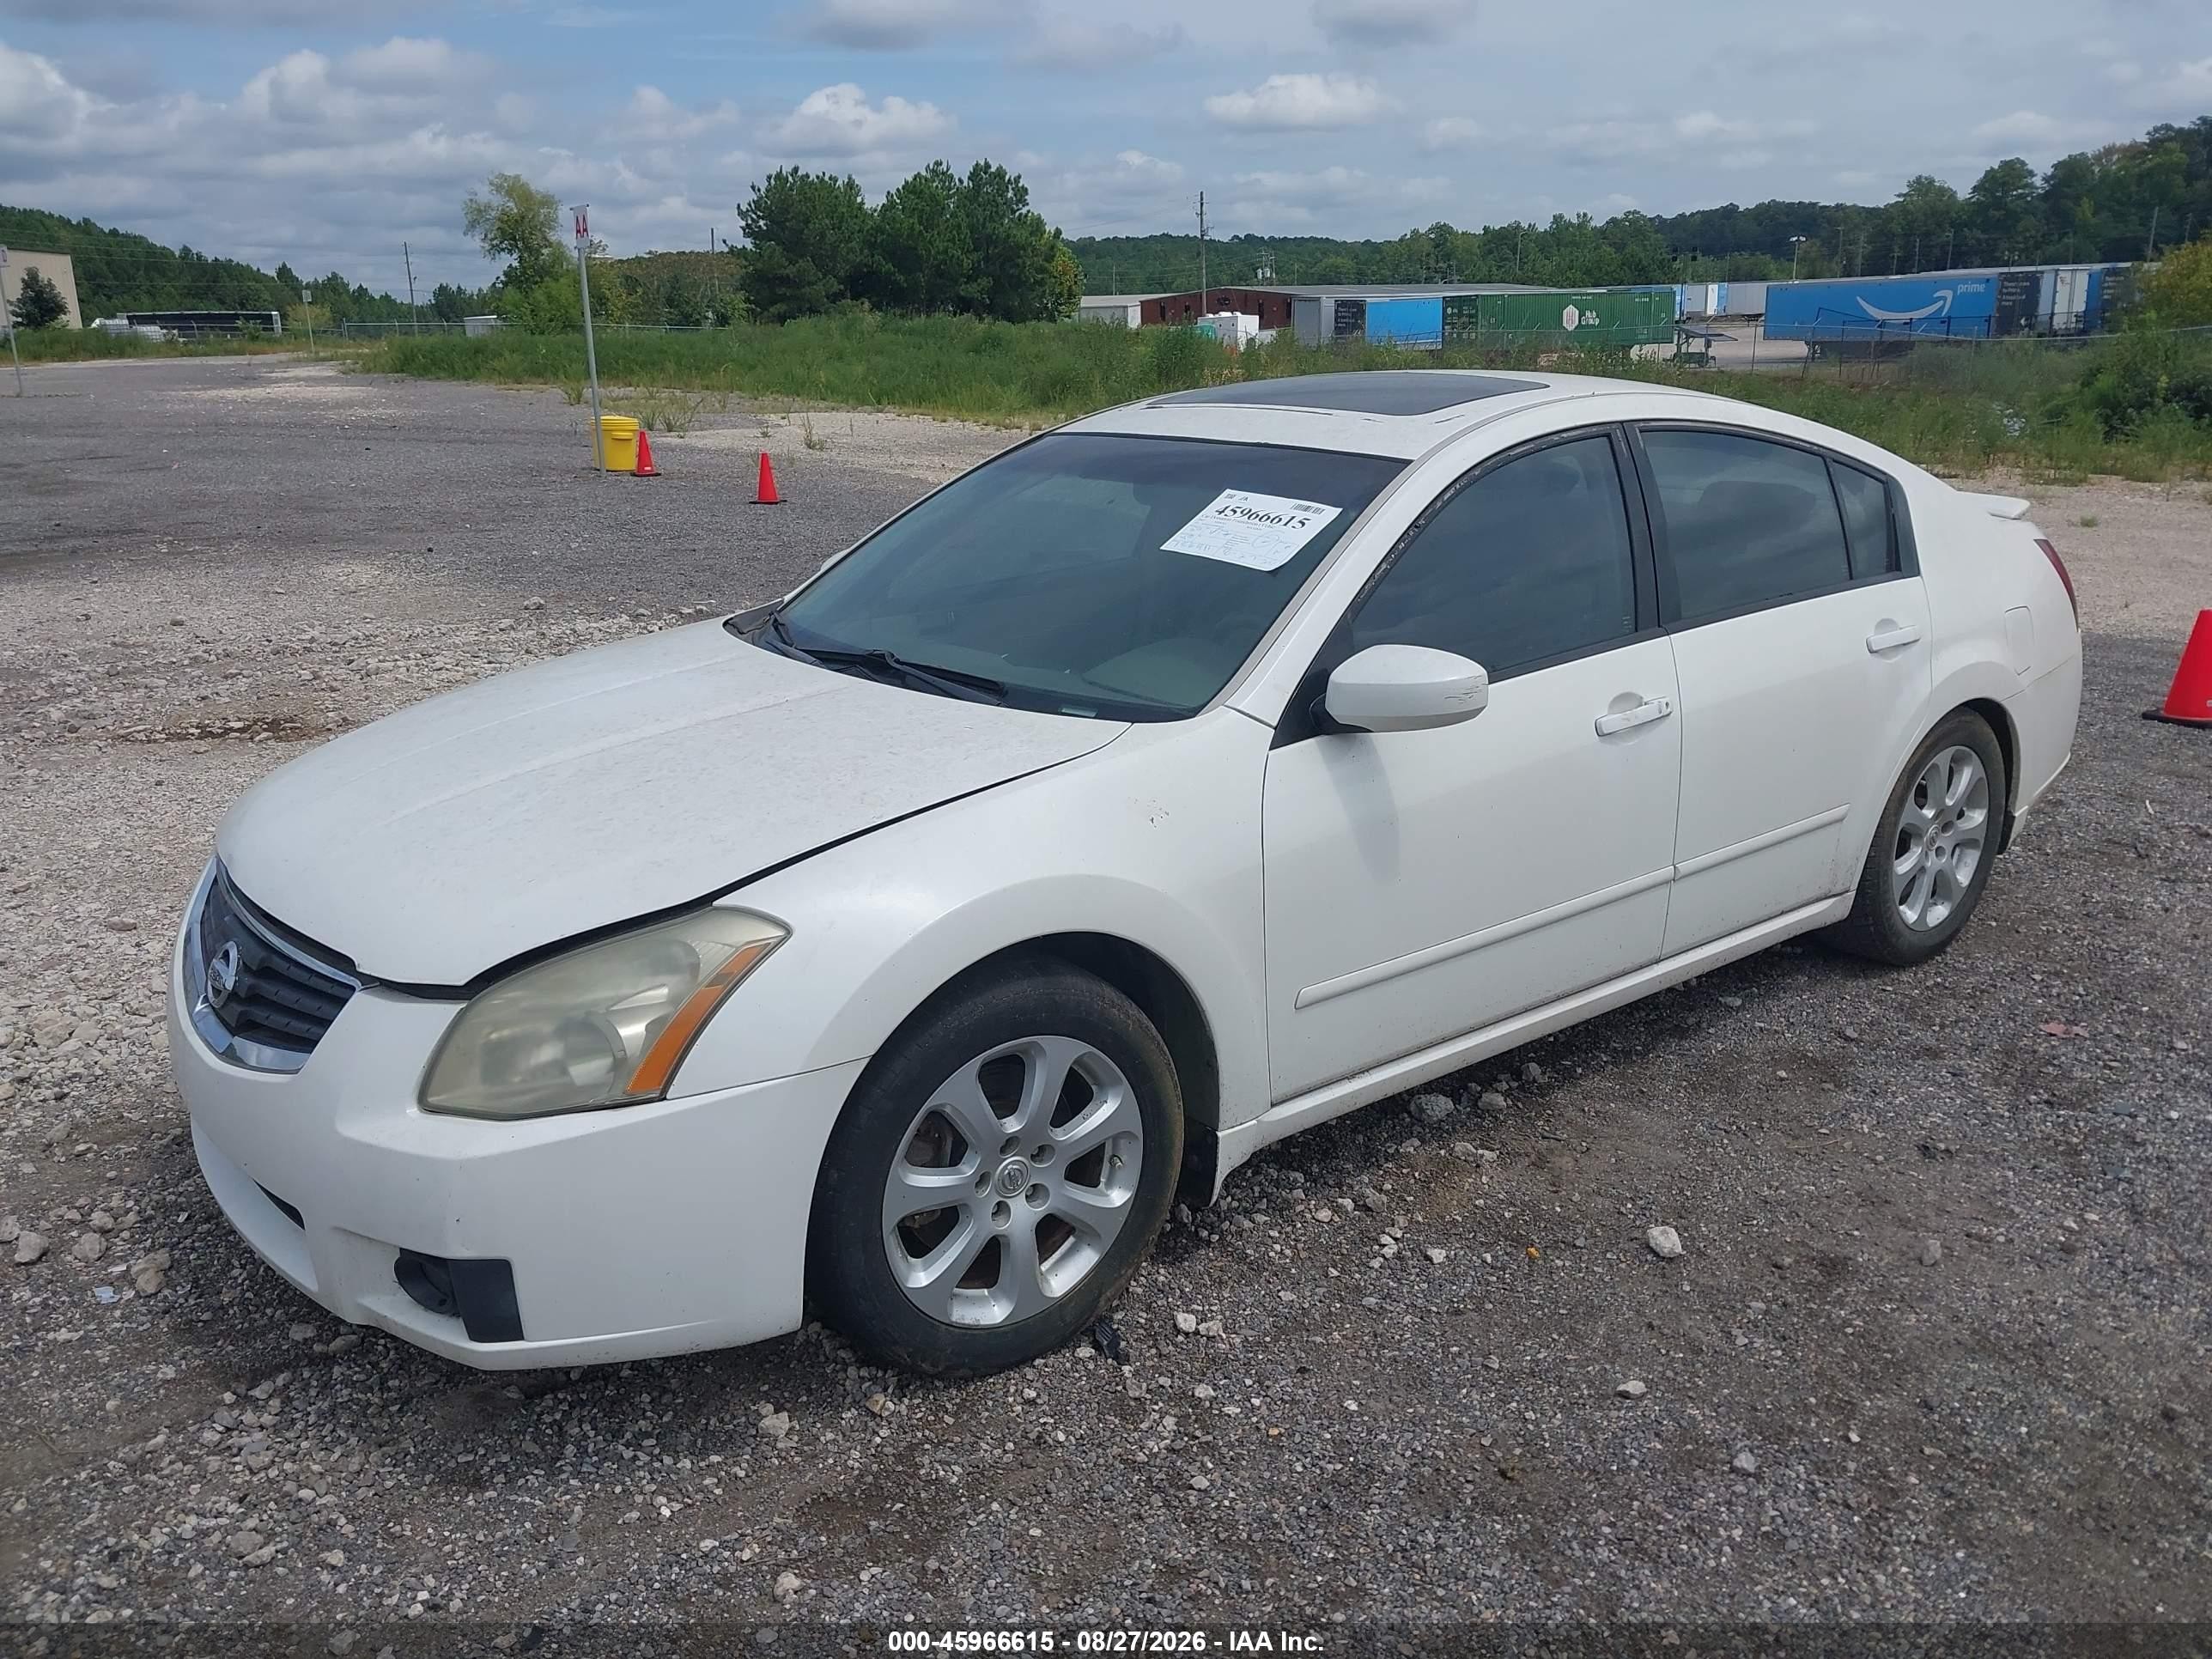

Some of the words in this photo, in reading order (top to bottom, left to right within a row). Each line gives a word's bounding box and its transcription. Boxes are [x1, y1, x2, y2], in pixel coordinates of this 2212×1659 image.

[575, 214, 589, 240] AA
[1957, 281, 1986, 296] prime
[1581, 316, 1600, 326] Group
[1215, 504, 1312, 530] 45966615
